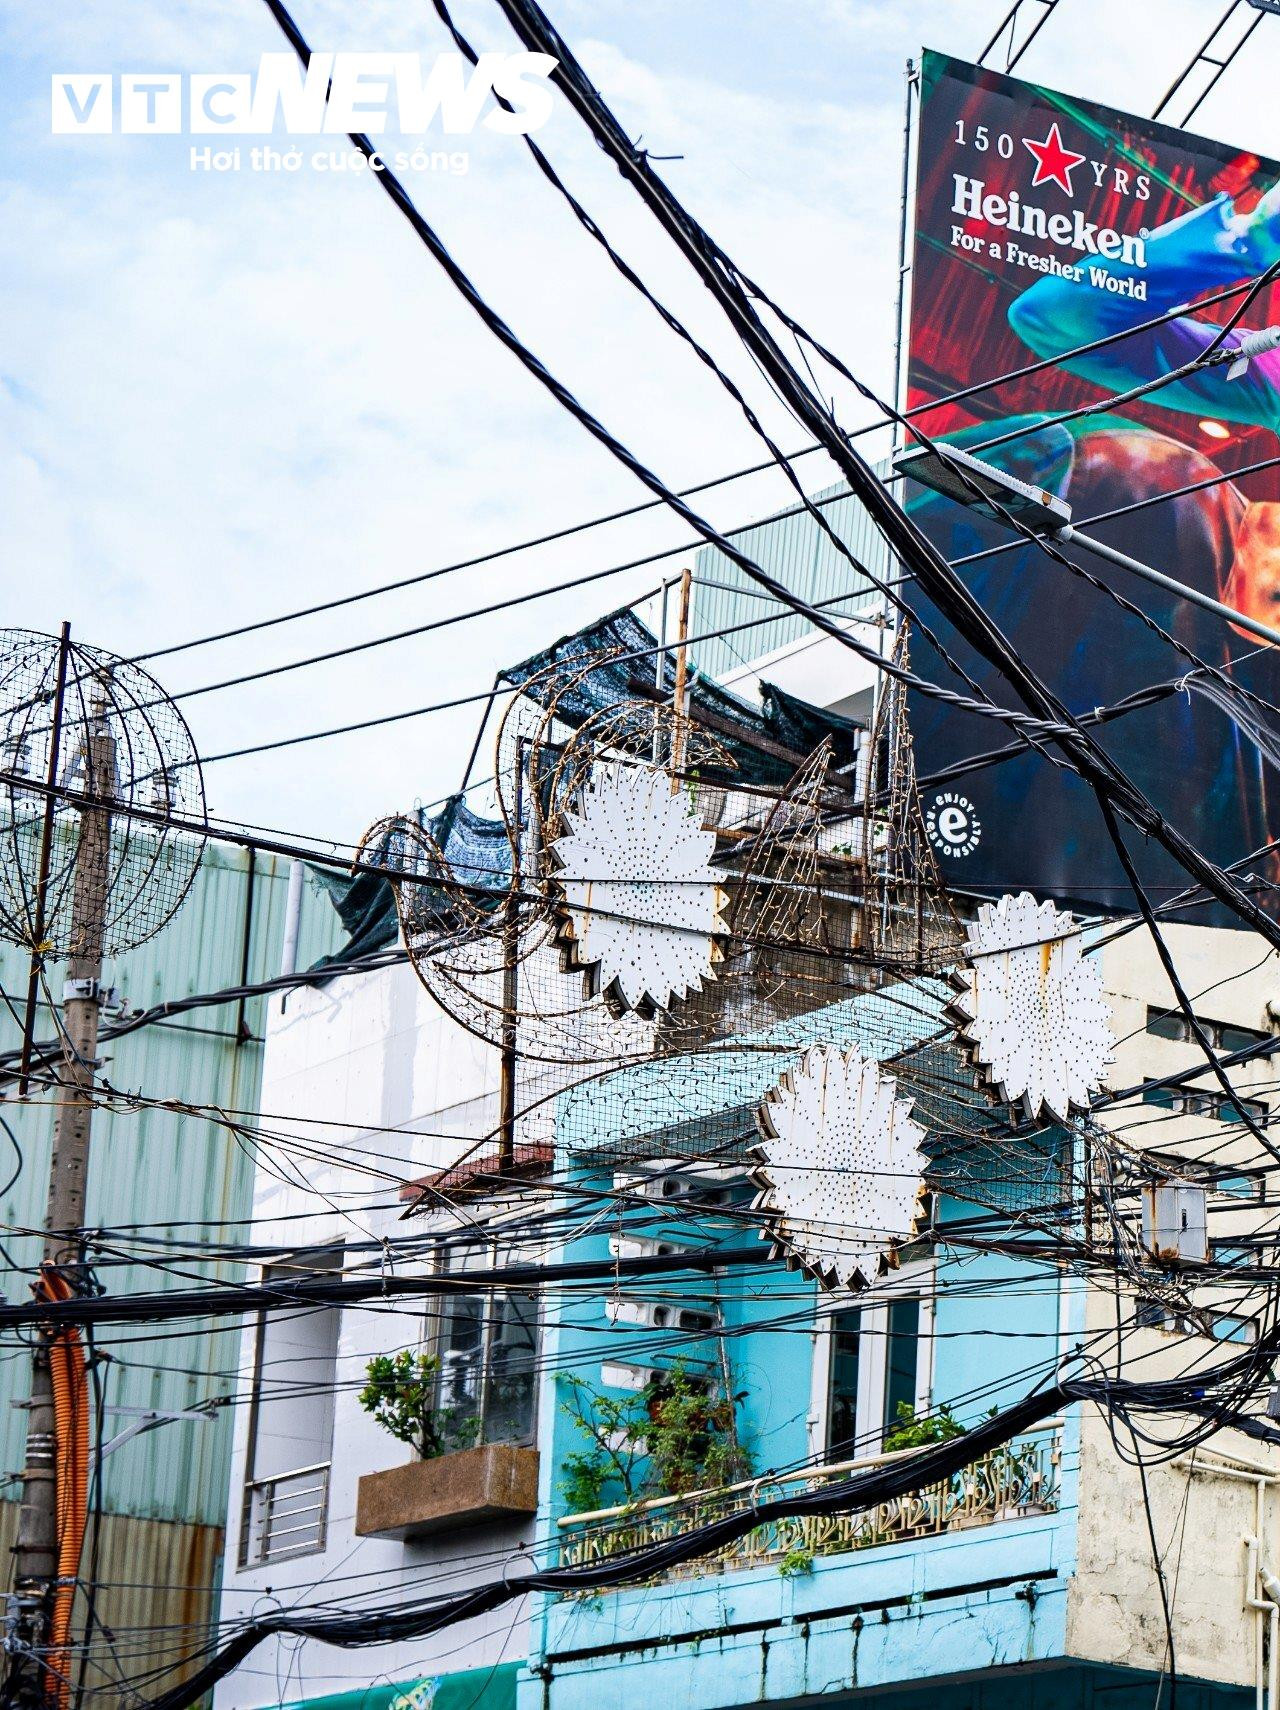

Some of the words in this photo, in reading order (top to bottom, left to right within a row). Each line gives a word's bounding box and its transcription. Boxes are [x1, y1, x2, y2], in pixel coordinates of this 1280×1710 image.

[954, 119, 1014, 159] 150
[1090, 160, 1151, 201] YRS
[951, 173, 1148, 268] Heineken
[950, 225, 986, 254] For
[988, 242, 1002, 260] a
[1005, 241, 1085, 283] Fresher
[1088, 264, 1148, 302] World
